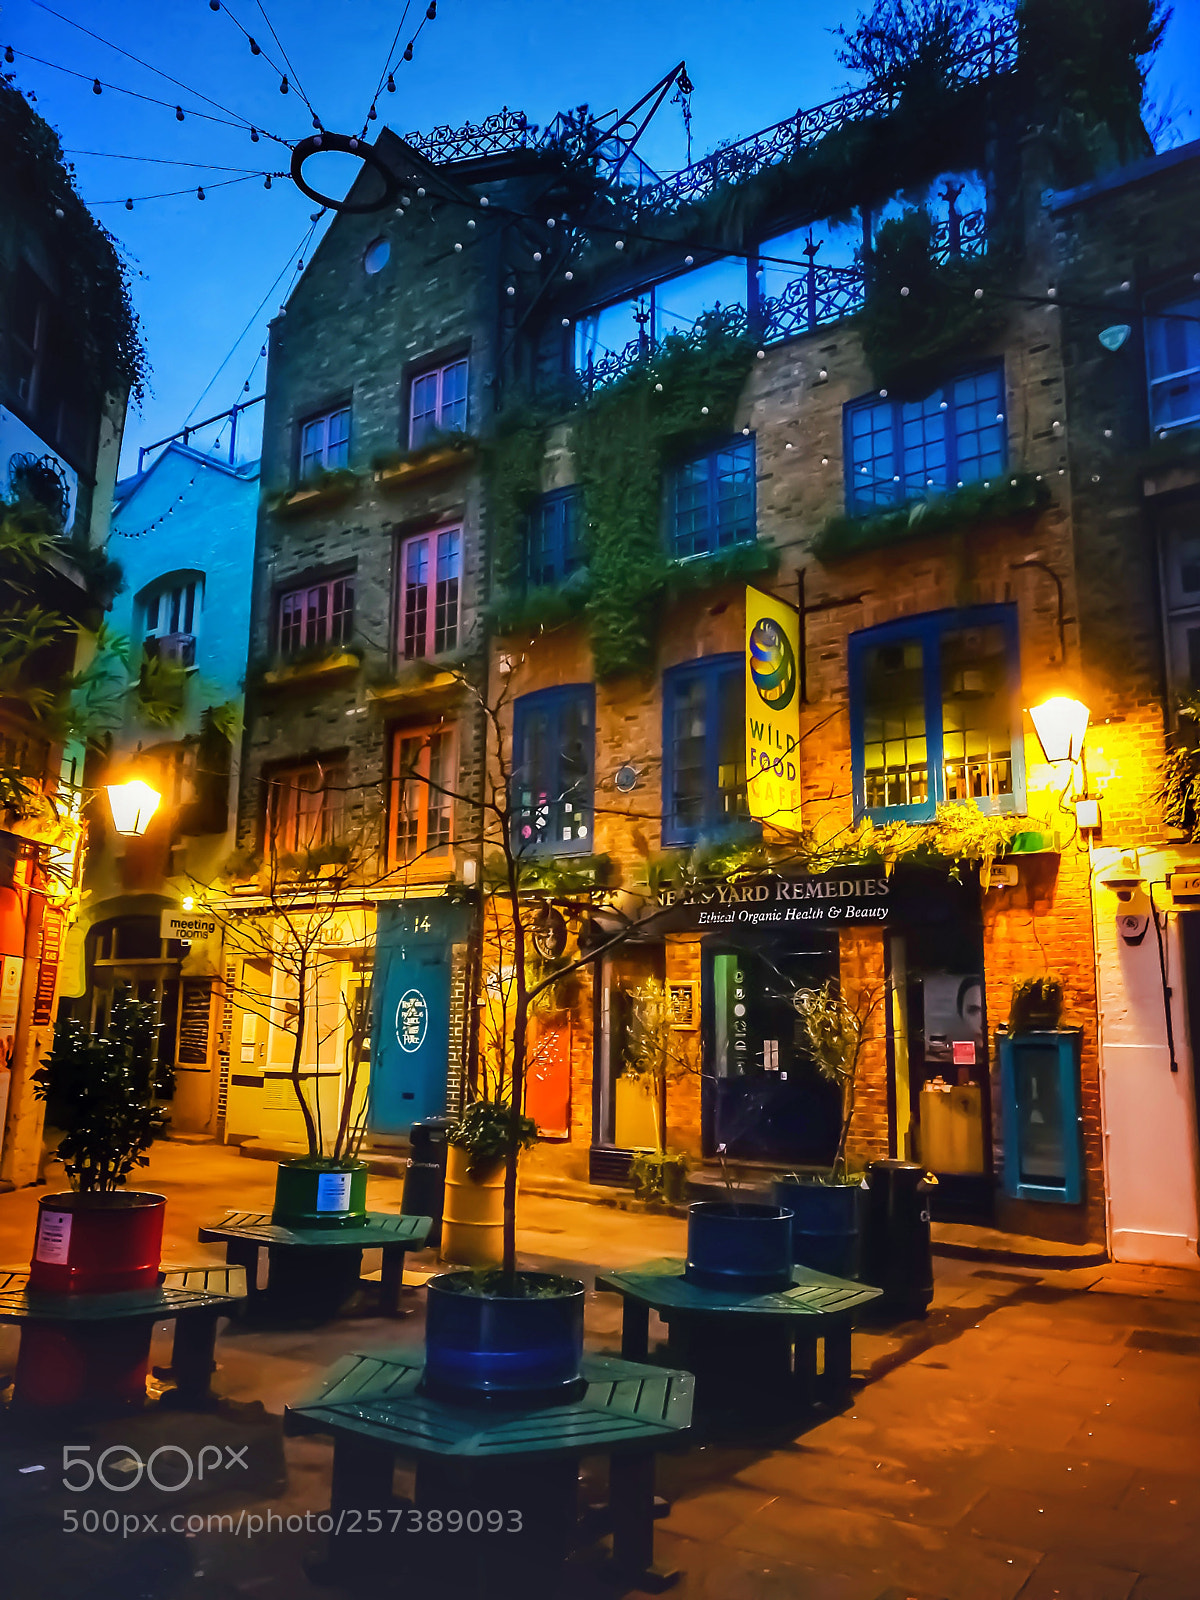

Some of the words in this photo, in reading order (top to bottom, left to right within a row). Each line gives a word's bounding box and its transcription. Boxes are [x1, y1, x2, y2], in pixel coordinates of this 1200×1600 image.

[749, 717, 796, 754] WILD
[750, 747, 796, 782] FOOD
[716, 884, 770, 905] YARD
[775, 879, 890, 901] REMEDIES
[414, 915, 431, 934] 14
[698, 910, 736, 924] Ethical
[738, 908, 781, 925] Organic
[785, 907, 824, 921] Health
[827, 905, 842, 919] &
[844, 905, 889, 920] Beauty
[170, 919, 215, 934] meeting
[175, 929, 209, 939] rooms
